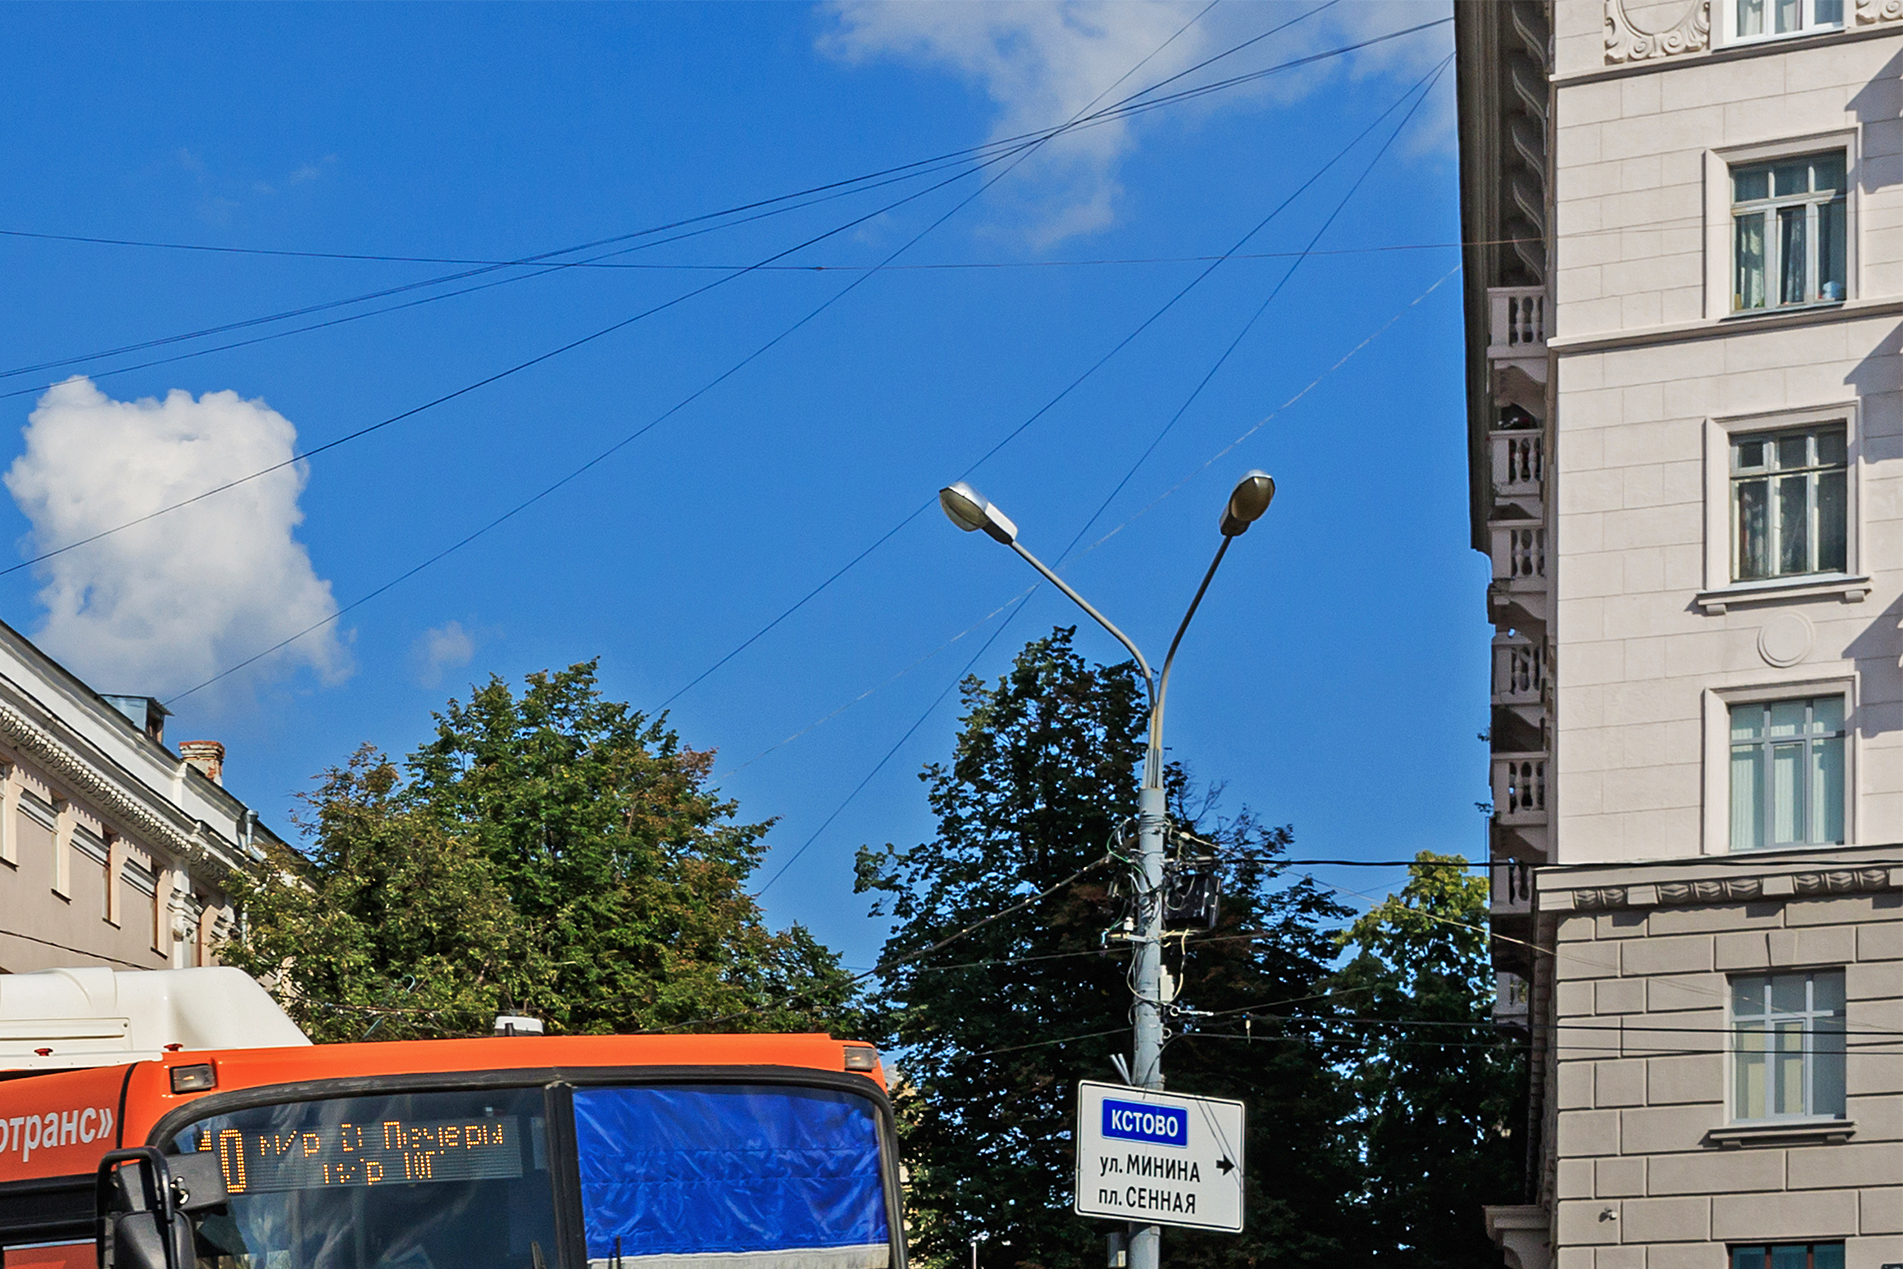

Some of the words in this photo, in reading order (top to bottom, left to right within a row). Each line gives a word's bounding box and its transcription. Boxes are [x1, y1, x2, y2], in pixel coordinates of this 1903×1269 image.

[1111, 1109, 1179, 1138] КСТОВО
[1100, 1156, 1123, 1177] ул.
[1126, 1153, 1201, 1183] МИНИНА
[1098, 1188, 1122, 1206] пл.
[1125, 1186, 1196, 1214] СЕННАЯ
